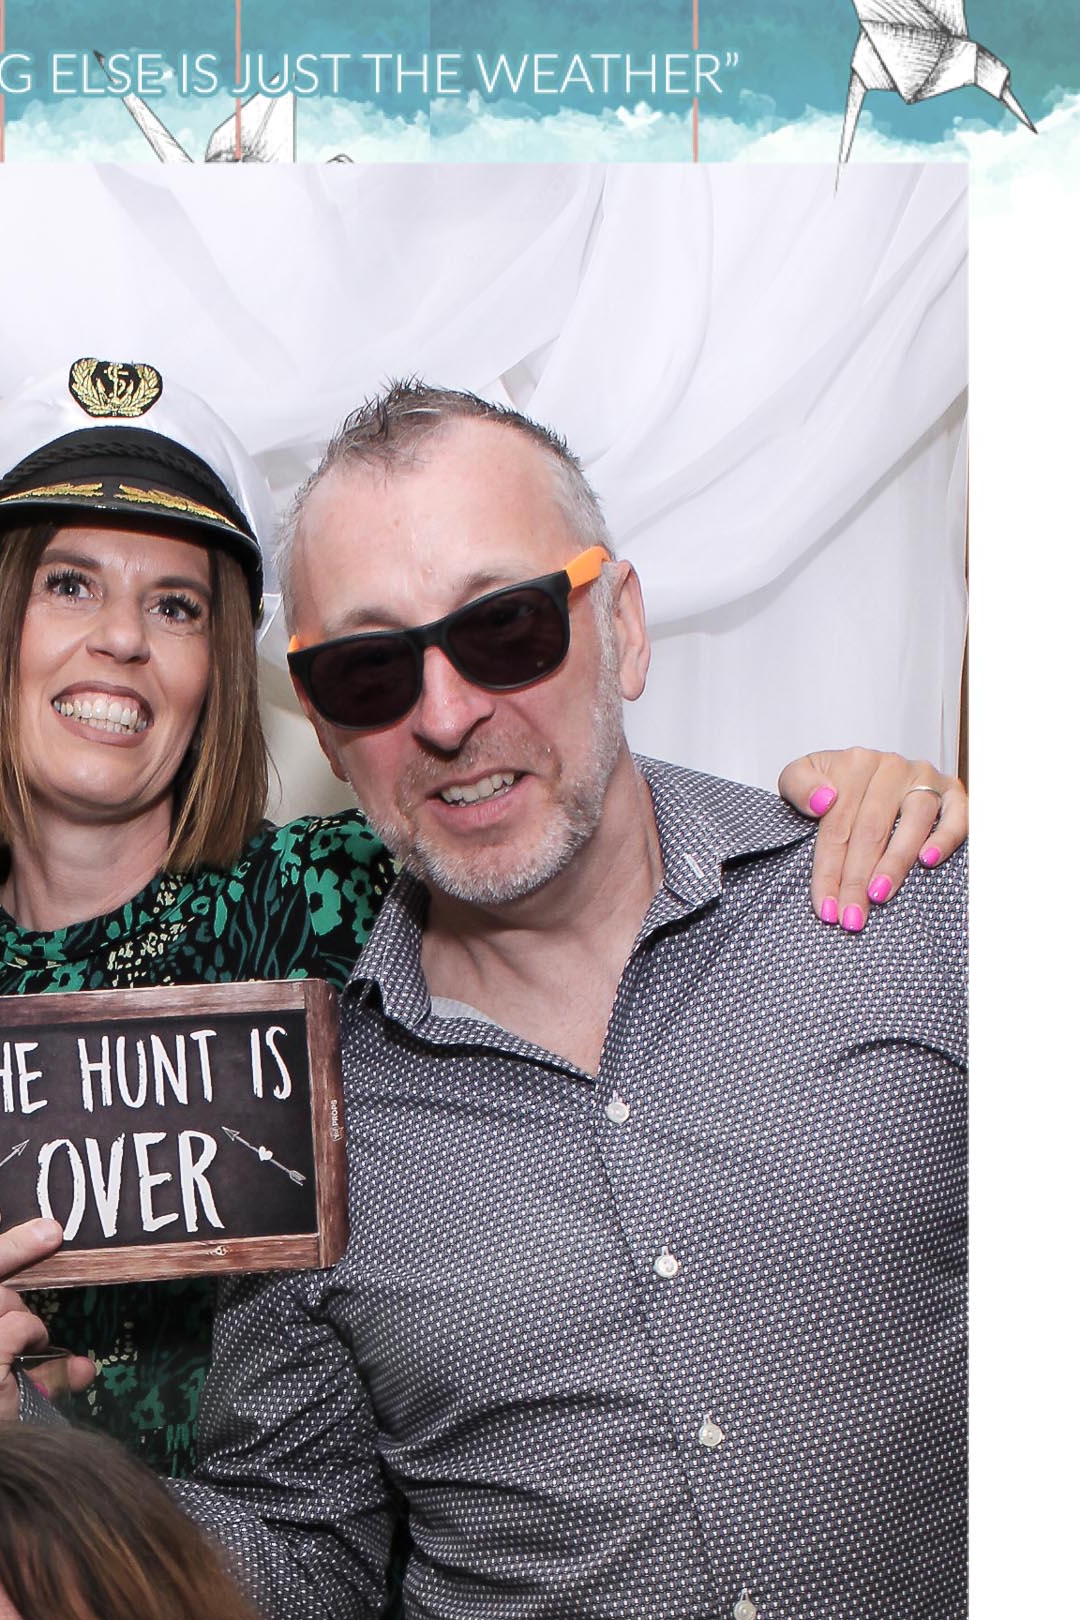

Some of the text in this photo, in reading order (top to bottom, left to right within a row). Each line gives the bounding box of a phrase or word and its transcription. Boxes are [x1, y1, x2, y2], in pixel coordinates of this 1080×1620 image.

[77, 1029, 217, 1113] HUNT
[250, 1026, 292, 1100] IS
[36, 1129, 225, 1241] OVER
